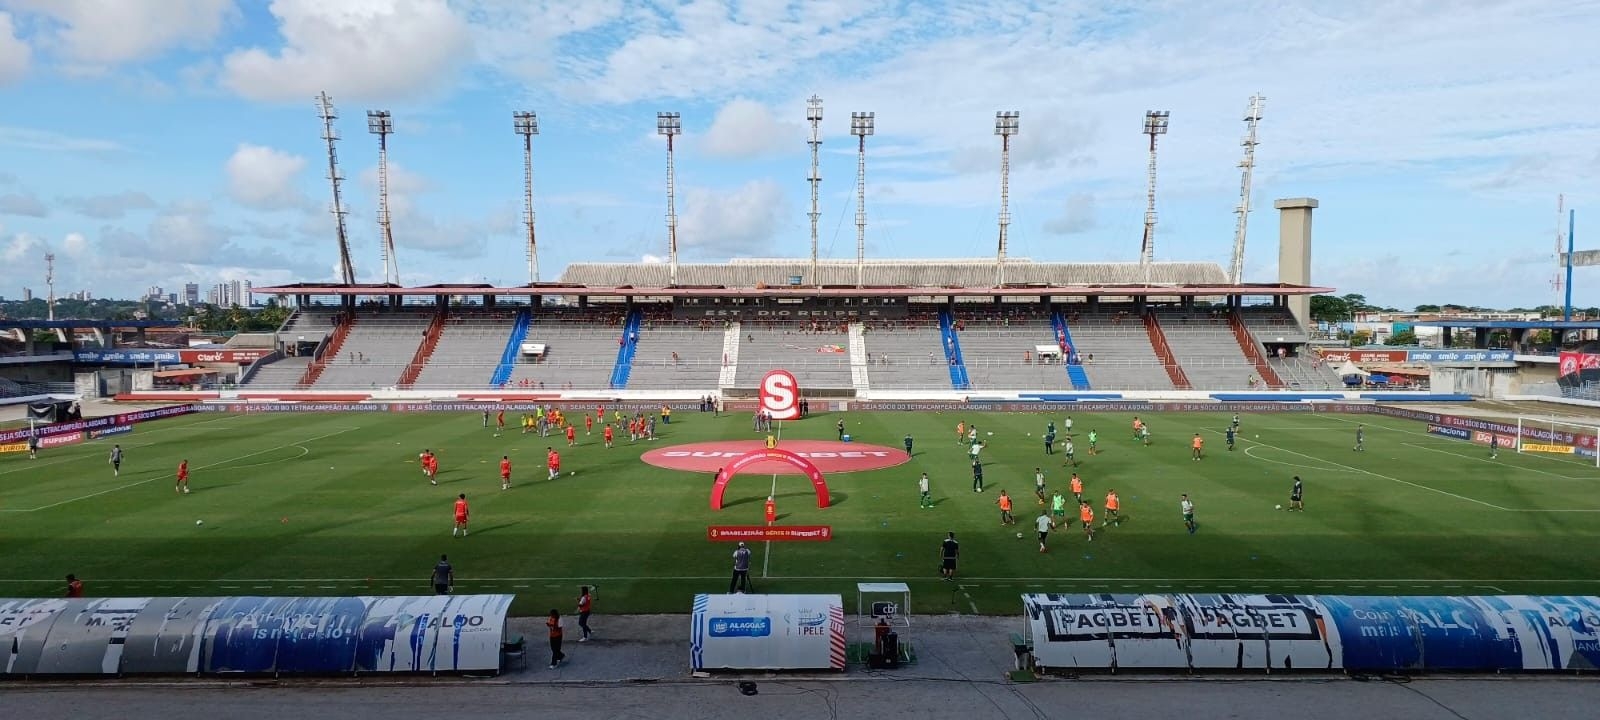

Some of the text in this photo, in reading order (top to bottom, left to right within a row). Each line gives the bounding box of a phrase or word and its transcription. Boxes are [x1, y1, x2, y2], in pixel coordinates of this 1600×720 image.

[198, 352, 222, 361] Claro
[764, 374, 794, 410] S
[43, 433, 81, 444] SUPERBET
[883, 604, 898, 614] cbf
